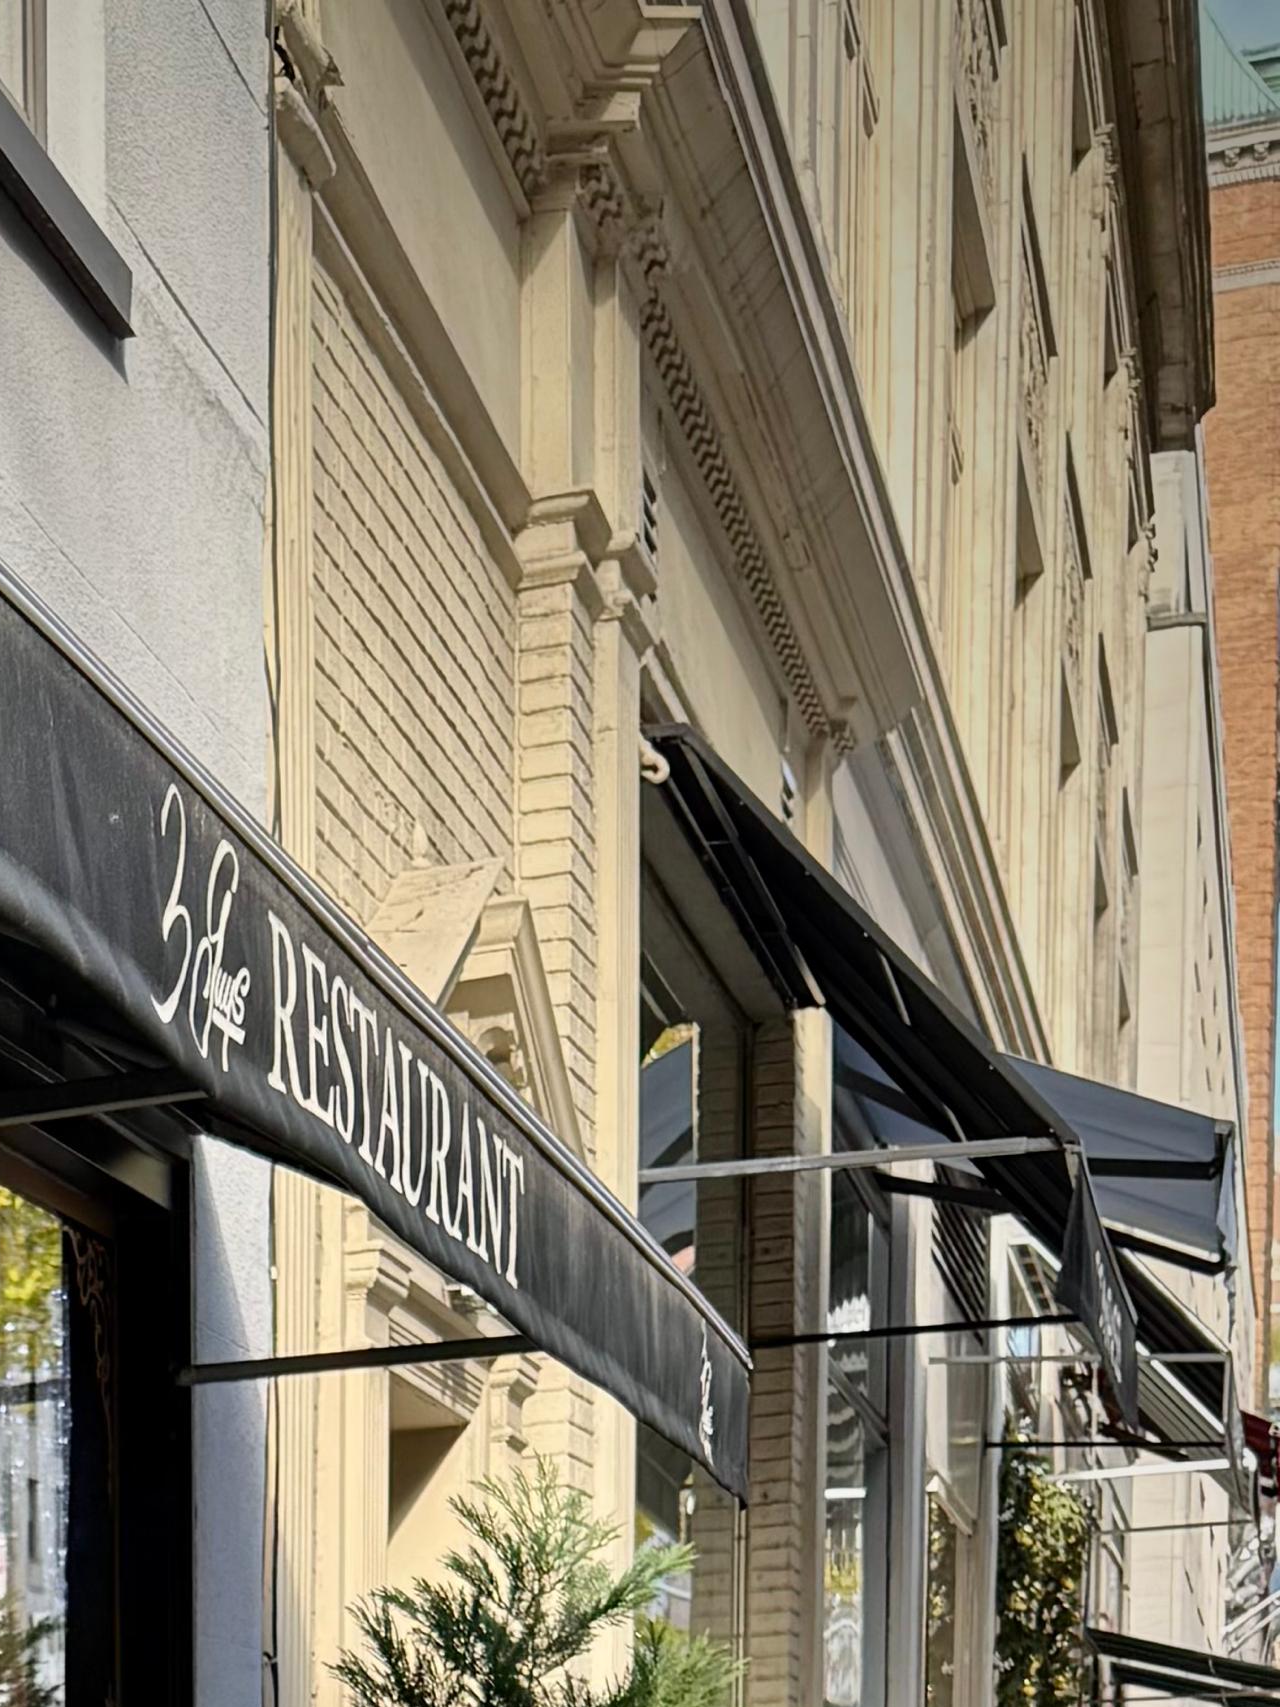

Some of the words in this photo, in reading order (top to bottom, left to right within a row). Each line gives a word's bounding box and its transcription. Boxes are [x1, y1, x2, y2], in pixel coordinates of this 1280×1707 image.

[151, 784, 192, 1024] 3
[190, 840, 251, 1073] Guys
[268, 911, 525, 1290] RESTAURANT
